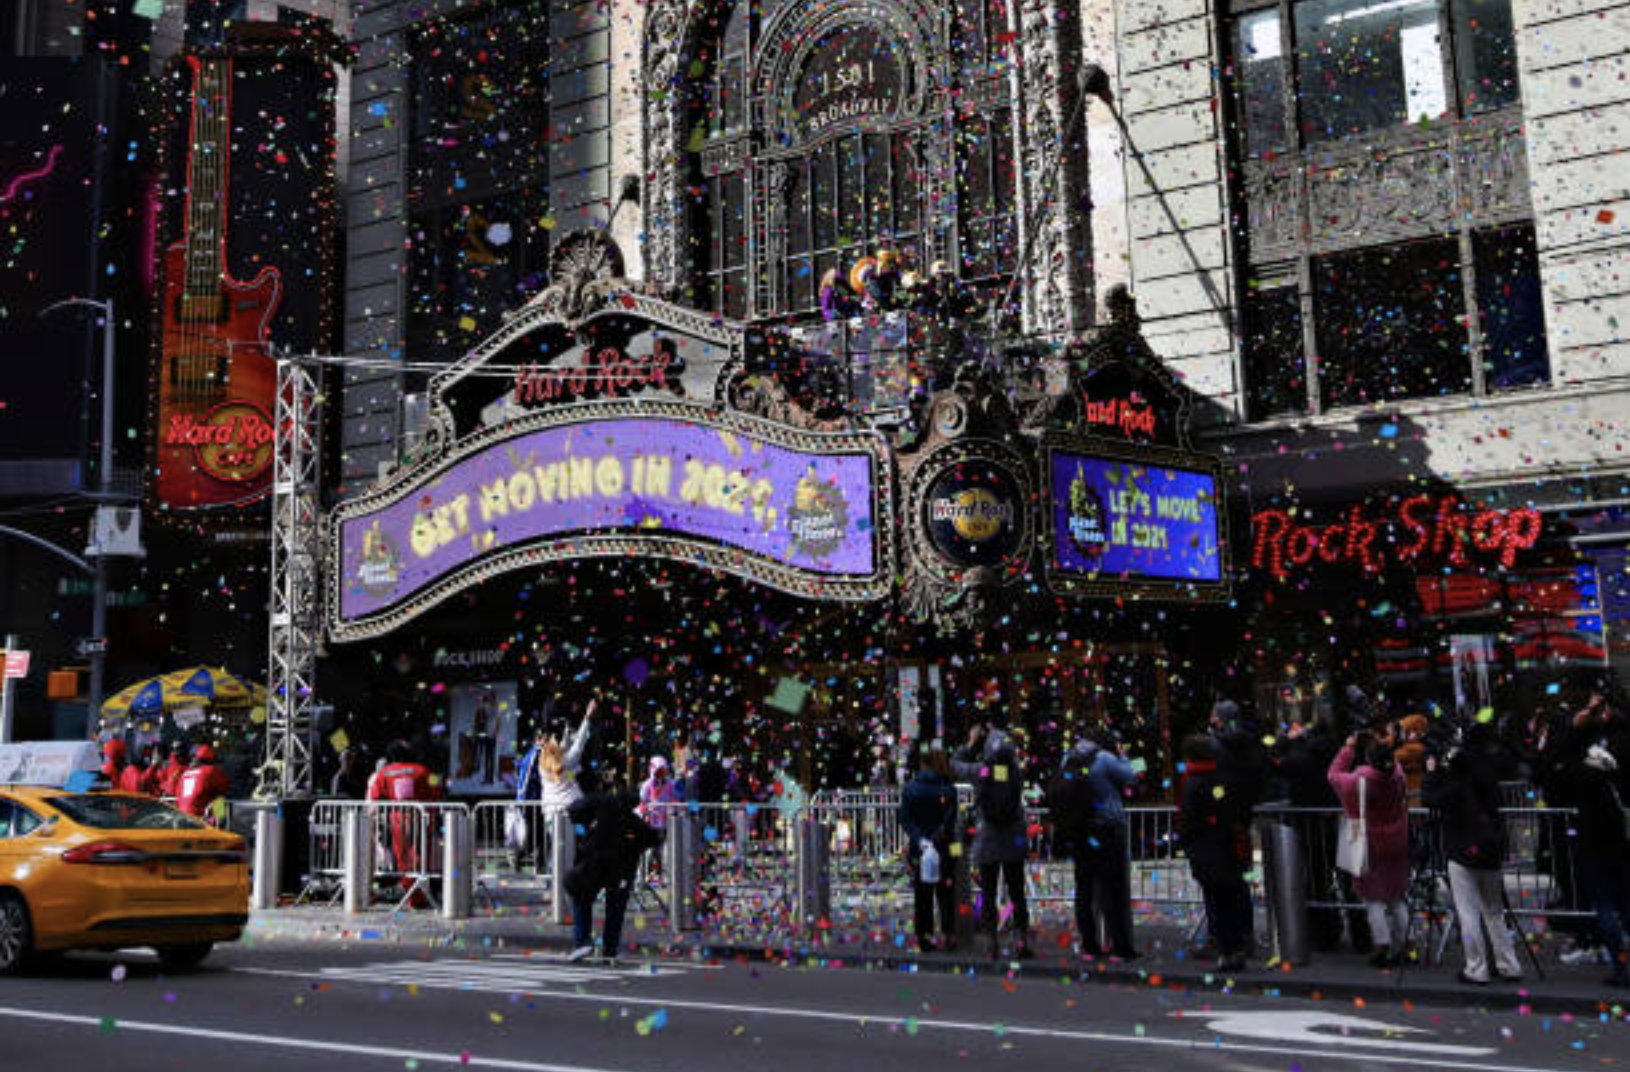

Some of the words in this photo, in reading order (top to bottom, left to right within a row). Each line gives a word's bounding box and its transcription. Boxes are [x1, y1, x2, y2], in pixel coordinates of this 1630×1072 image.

[513, 348, 591, 404] Hard
[594, 345, 671, 399] Rock
[168, 414, 235, 444] Hard
[410, 494, 469, 557] GET
[479, 456, 624, 521] MOVING
[631, 455, 672, 497] IN
[1157, 494, 1202, 523] MOVE
[1252, 503, 1383, 578] Rock
[1398, 494, 1542, 568] Shop
